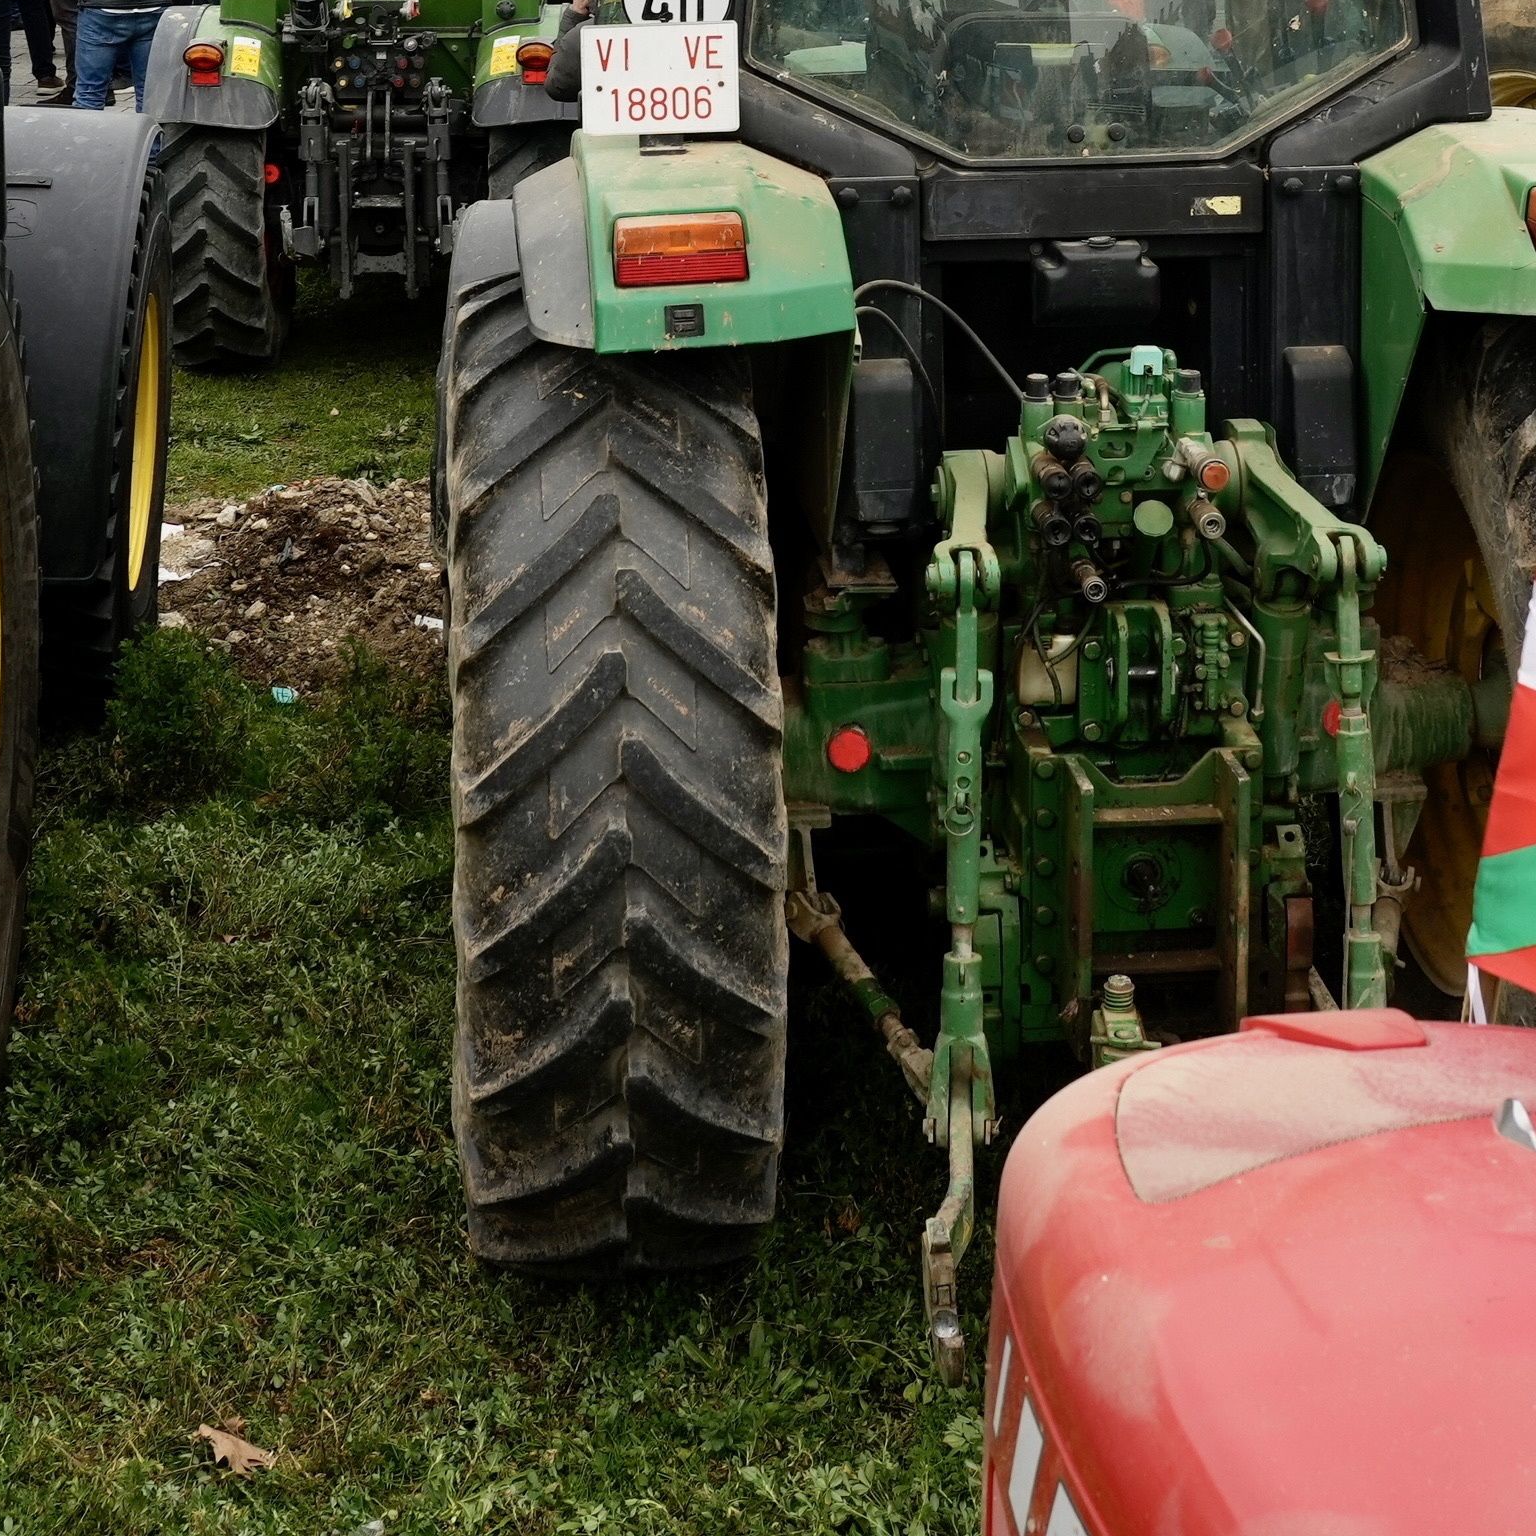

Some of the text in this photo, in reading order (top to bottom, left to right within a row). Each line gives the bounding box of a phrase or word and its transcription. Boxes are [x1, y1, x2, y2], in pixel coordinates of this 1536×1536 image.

[596, 35, 723, 72] VI VE
[611, 85, 712, 122] 18806
